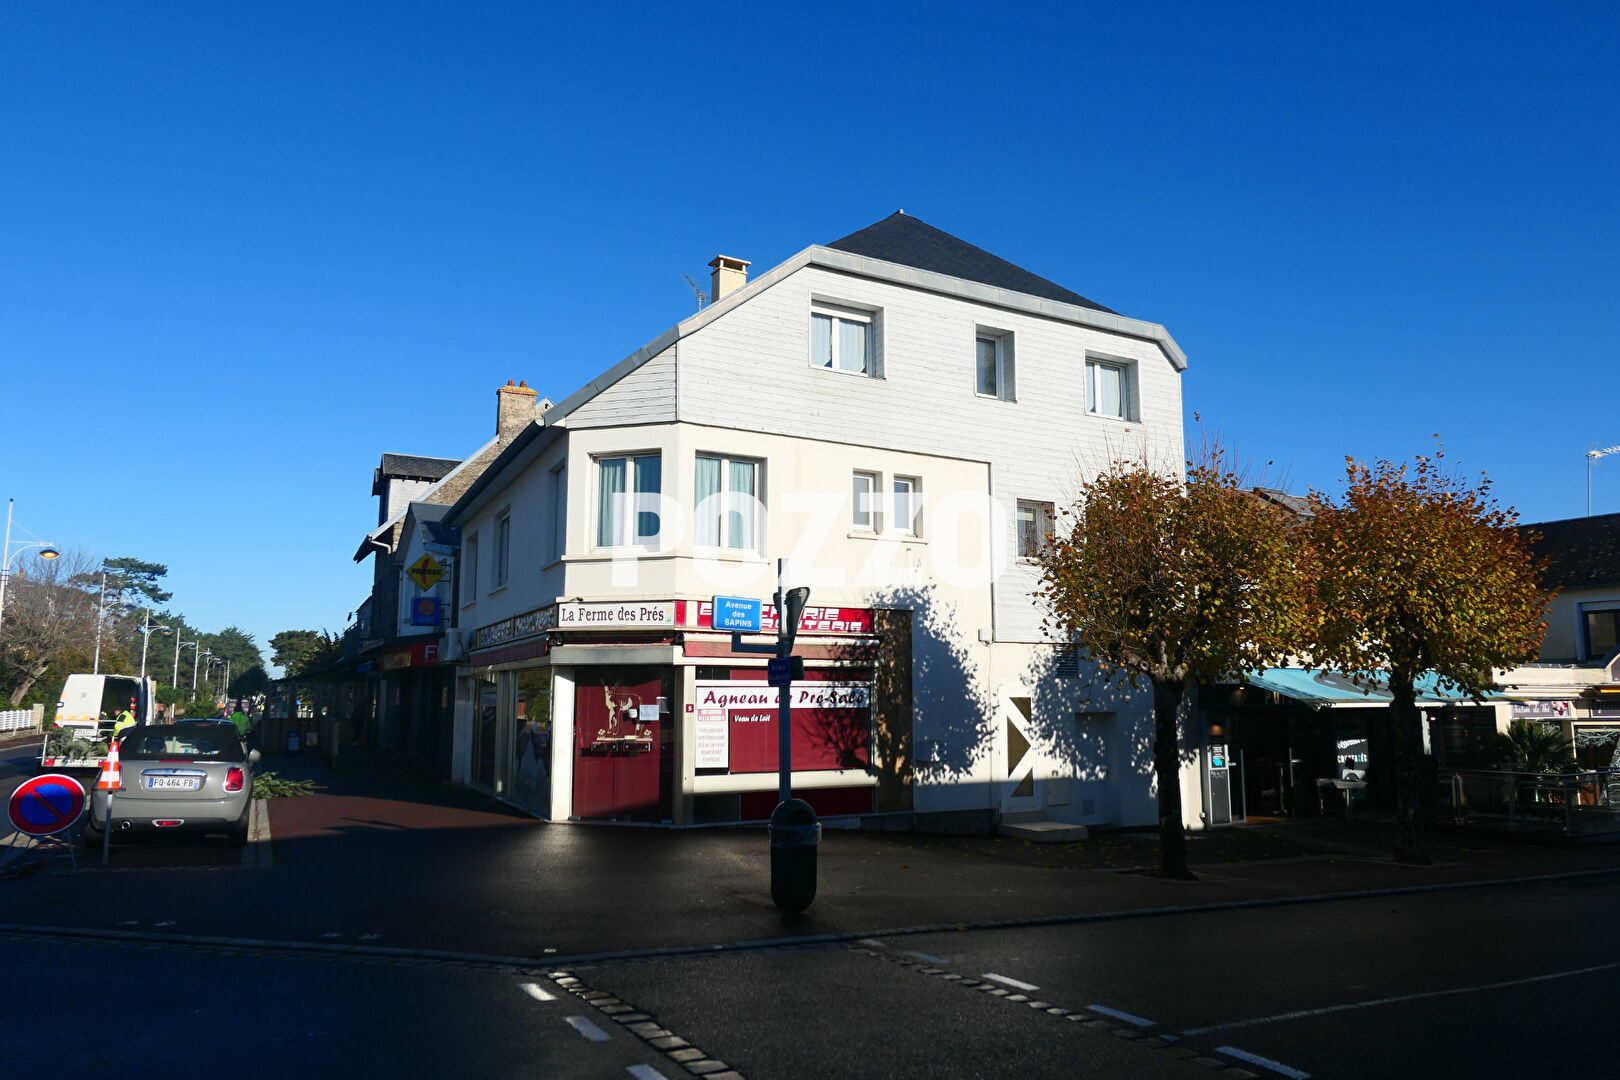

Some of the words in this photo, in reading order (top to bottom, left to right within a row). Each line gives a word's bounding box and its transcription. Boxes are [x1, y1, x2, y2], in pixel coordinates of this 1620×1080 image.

[725, 601, 752, 610] Avenue
[561, 608, 575, 622] La
[578, 607, 614, 622] Ferme
[617, 606, 636, 621] des
[640, 605, 664, 621] Prés
[732, 610, 745, 618] des
[724, 618, 752, 627] SAPINS
[704, 690, 768, 708] Agneau
[799, 690, 865, 705] Pré-Salé
